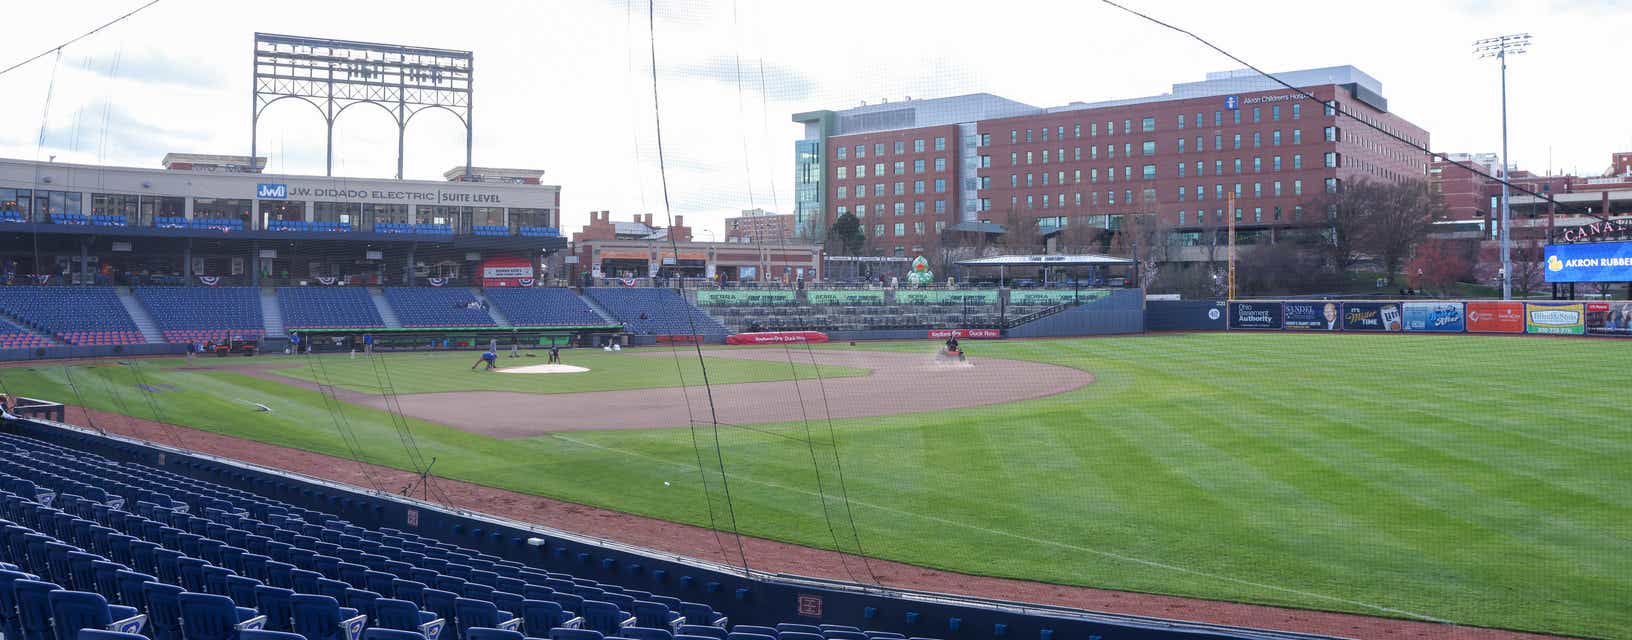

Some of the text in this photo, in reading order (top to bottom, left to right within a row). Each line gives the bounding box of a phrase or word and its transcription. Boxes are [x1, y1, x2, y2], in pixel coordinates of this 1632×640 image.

[314, 188, 368, 199] DIDADO
[371, 190, 434, 201] ELECTRIC
[442, 193, 502, 203] SUITE LEVEL
[1566, 257, 1632, 267] AKRON RUBBE
[1239, 315, 1272, 323] Authority
